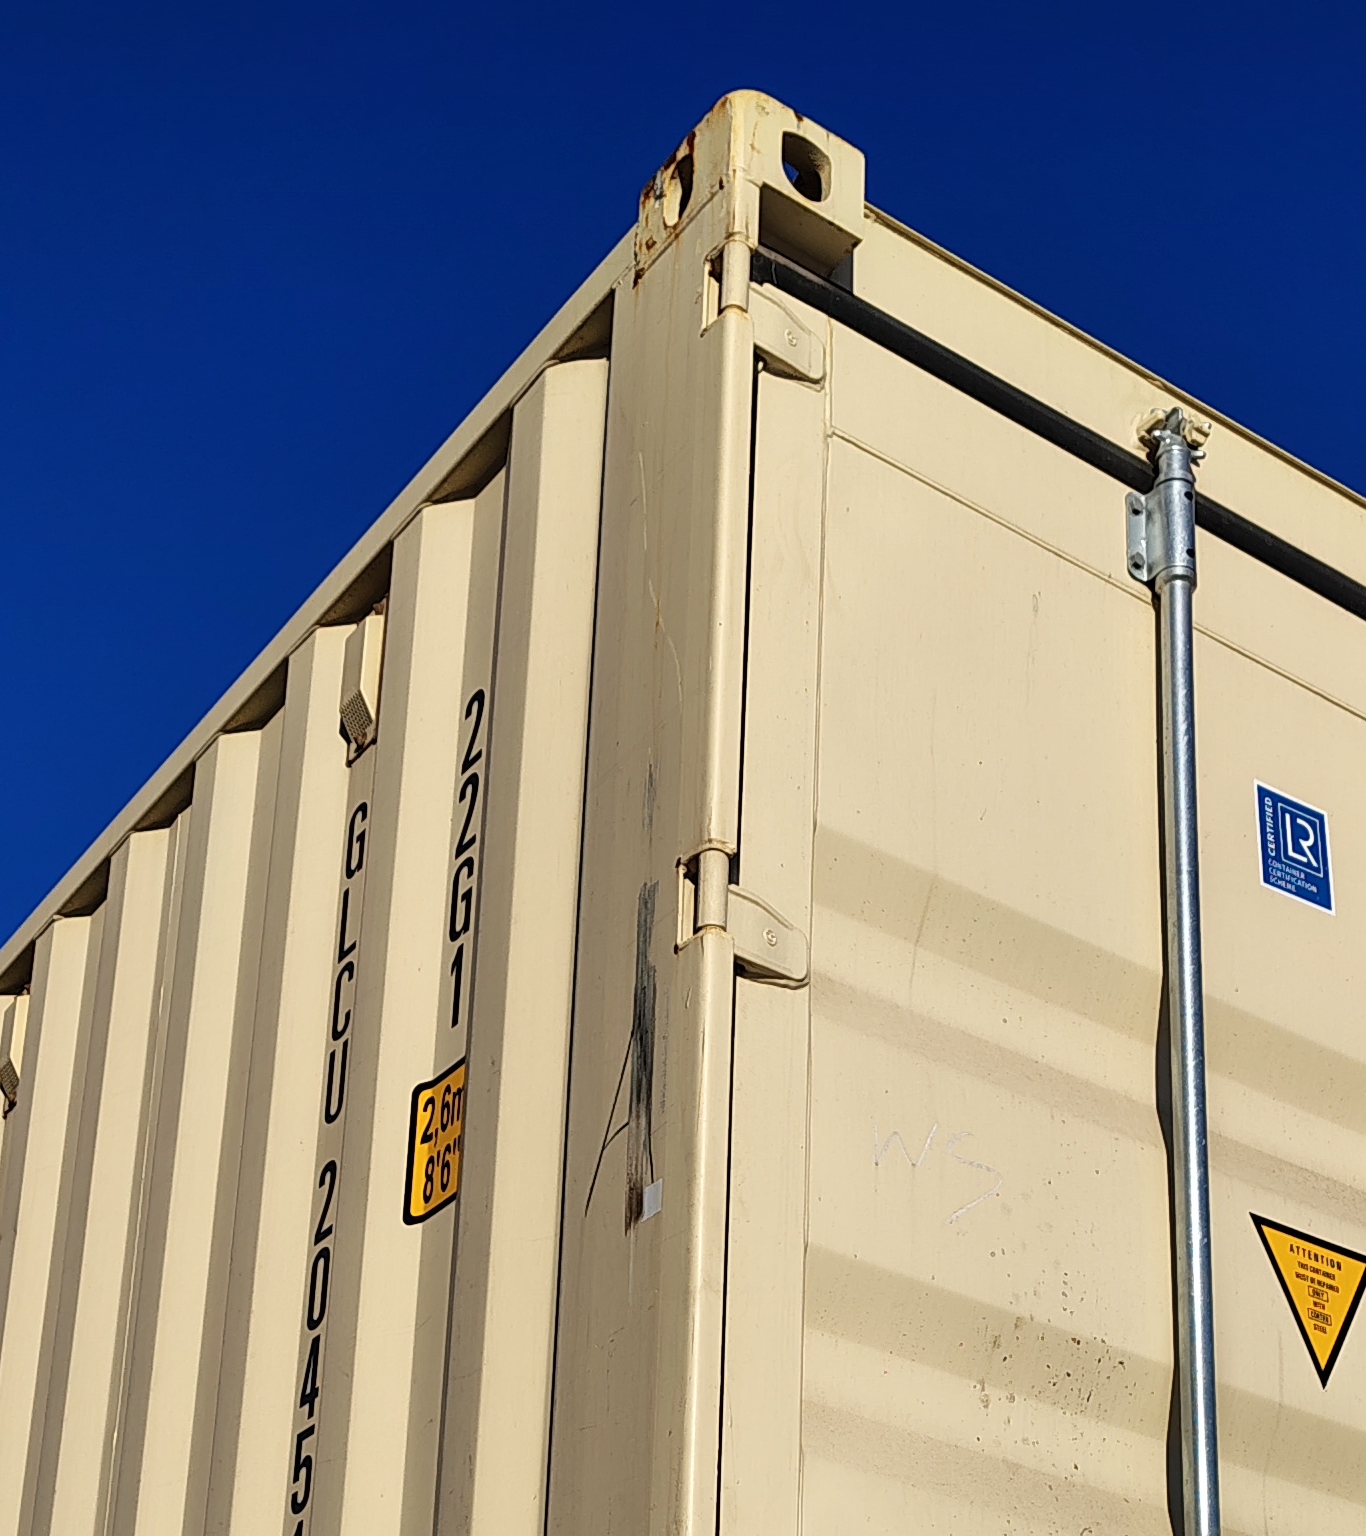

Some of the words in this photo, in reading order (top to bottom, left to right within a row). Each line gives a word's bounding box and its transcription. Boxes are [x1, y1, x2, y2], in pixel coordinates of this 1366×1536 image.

[1264, 796, 1276, 857] CERTIFIED
[1285, 812, 1318, 867] LR
[448, 688, 486, 1029] 22G1
[1268, 866, 1318, 893] CERTIFICATION
[324, 800, 369, 1125] GLCU
[1289, 1243, 1342, 1271] ATTENTION
